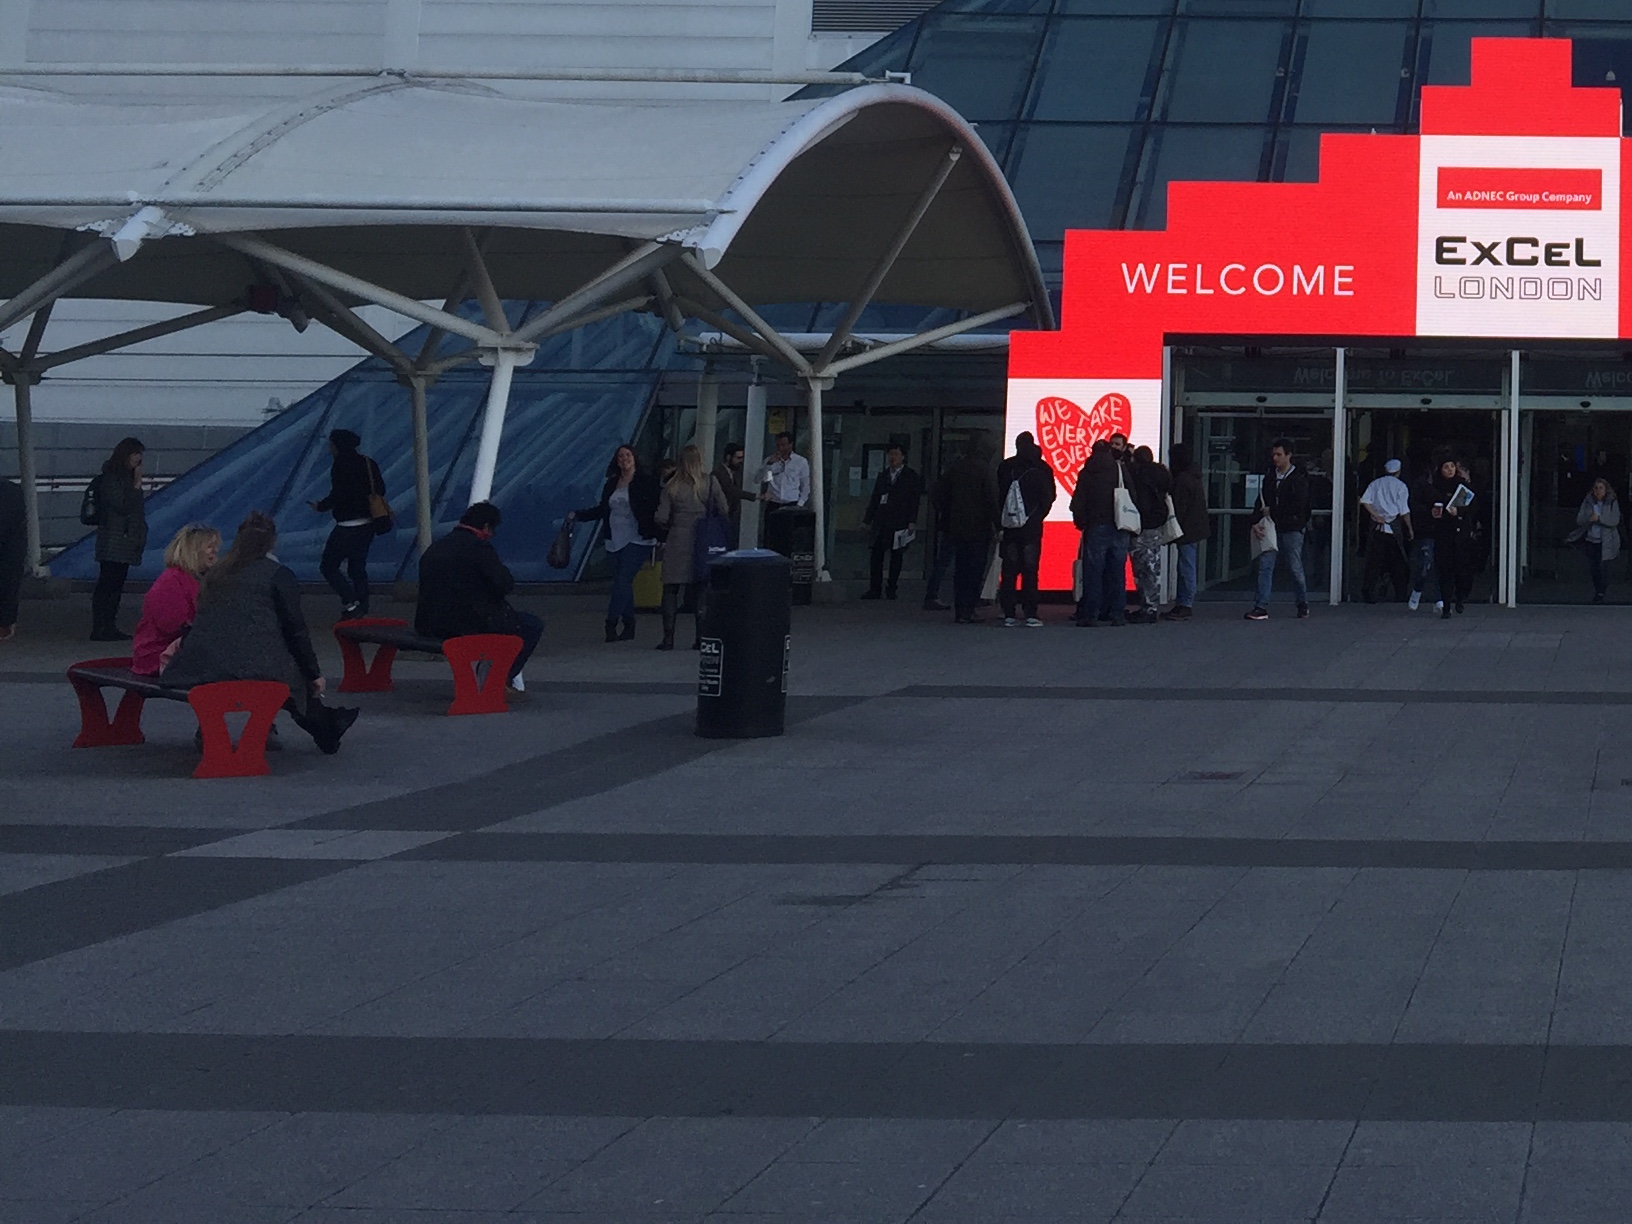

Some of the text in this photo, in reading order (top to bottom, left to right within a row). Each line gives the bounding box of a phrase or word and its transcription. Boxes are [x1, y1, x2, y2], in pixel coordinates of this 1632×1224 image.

[1447, 191, 1592, 205] An ADNEC Group Company
[1121, 263, 1355, 296] WELCOME
[1434, 276, 1602, 301] LONDON
[1040, 396, 1123, 427] WE TAKE
[1042, 423, 1099, 449] EVERY
